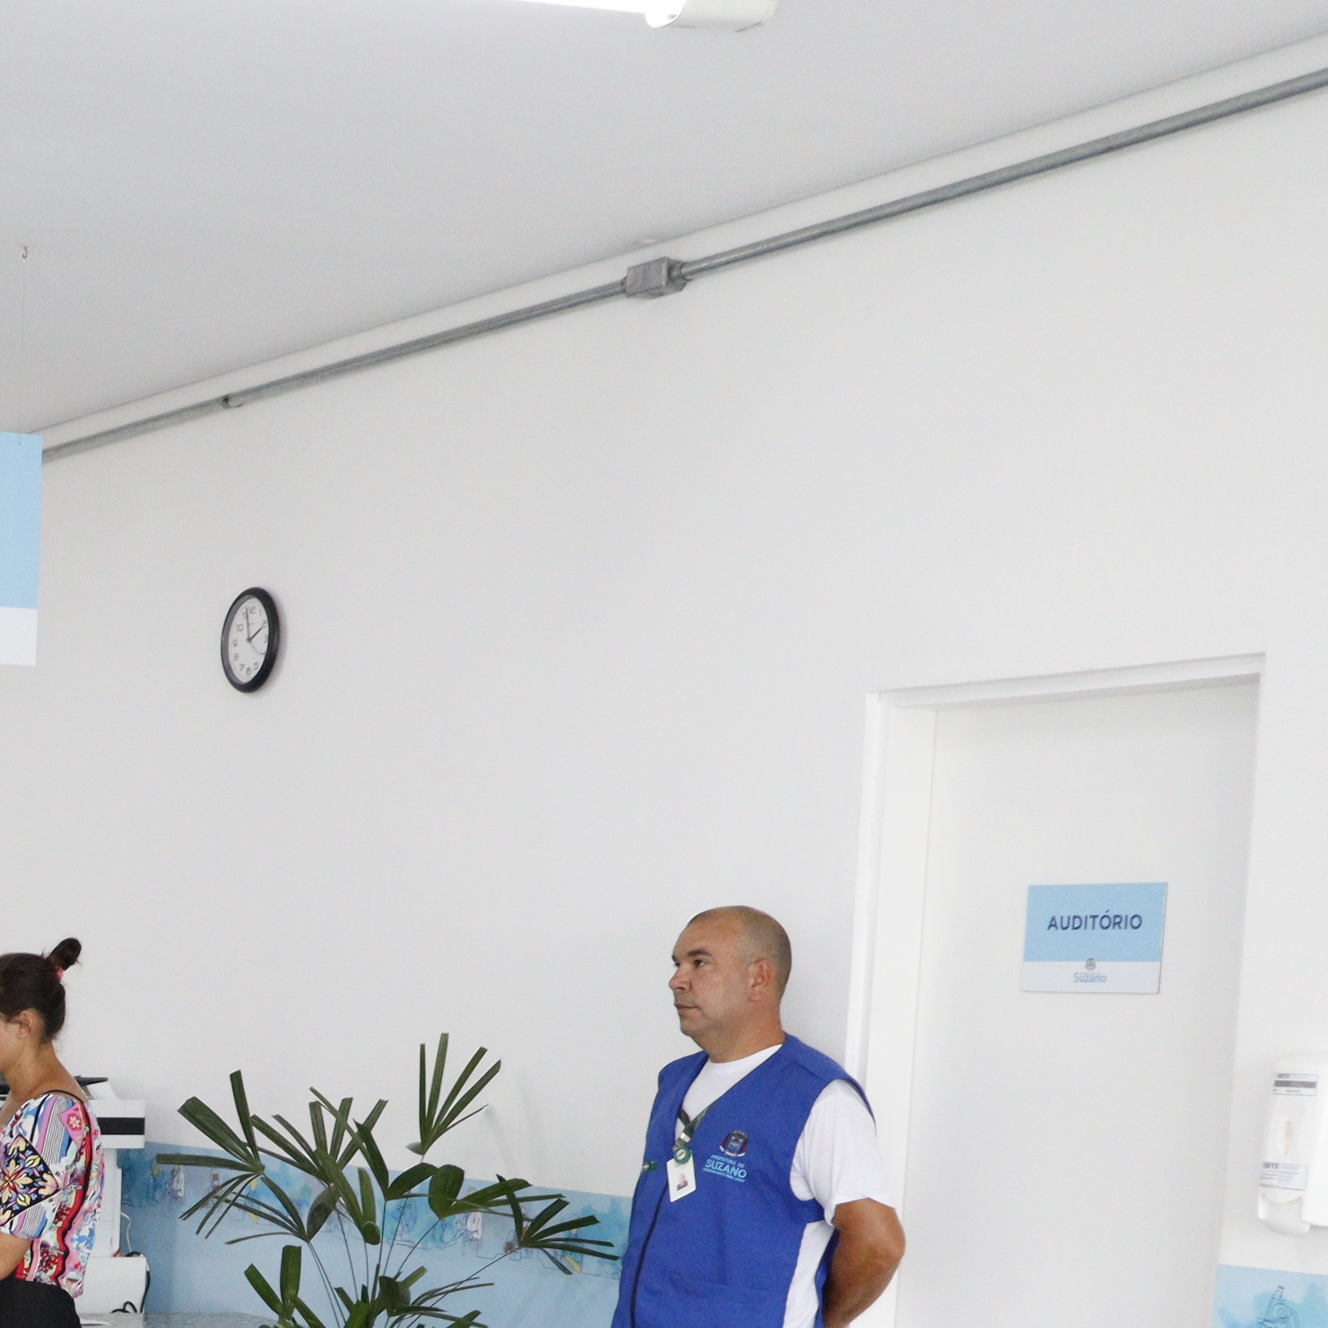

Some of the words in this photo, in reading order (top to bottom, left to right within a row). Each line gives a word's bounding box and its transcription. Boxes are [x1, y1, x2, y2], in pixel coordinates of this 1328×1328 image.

[1047, 910, 1143, 931] AUDITÓRIO
[1074, 972, 1107, 982] Suzano
[705, 1159, 747, 1178] SUZANO
